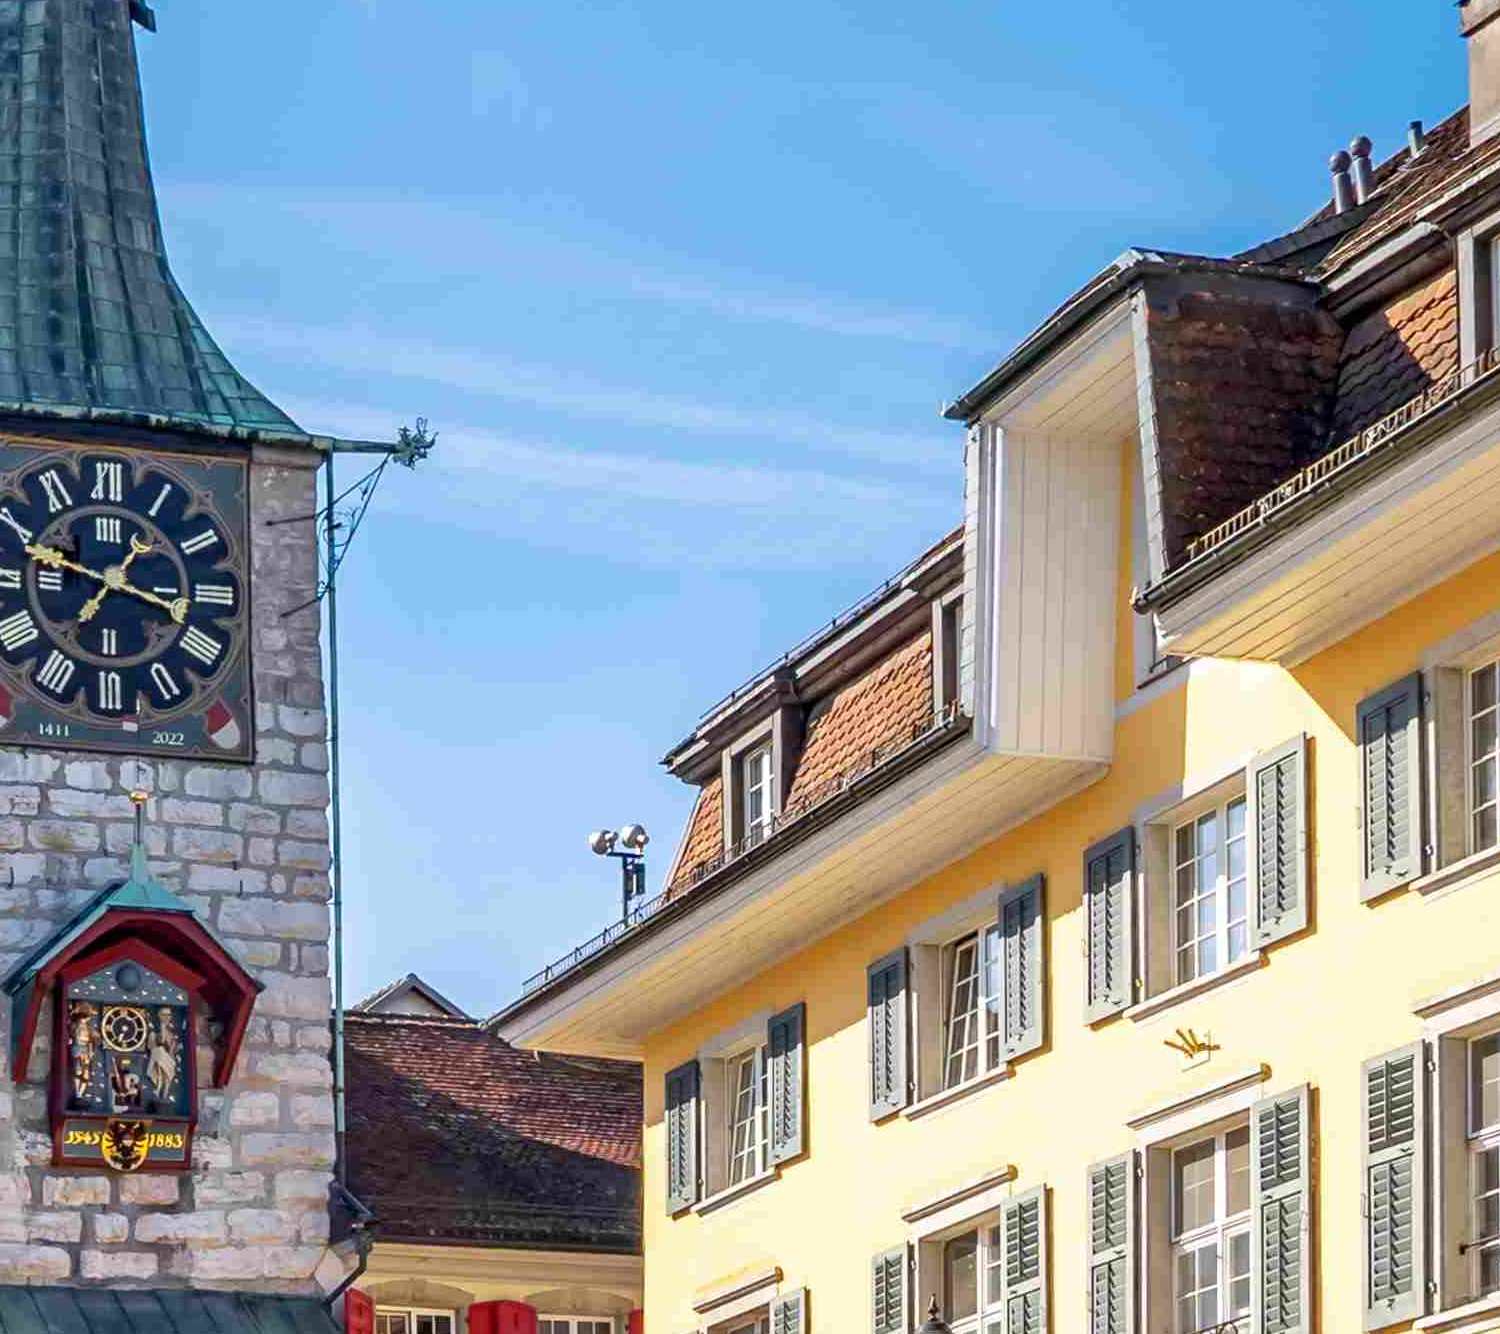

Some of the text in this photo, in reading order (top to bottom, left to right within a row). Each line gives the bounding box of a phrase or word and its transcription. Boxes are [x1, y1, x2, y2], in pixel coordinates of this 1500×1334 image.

[39, 722, 69, 737] 1411
[152, 731, 184, 746] 2022
[149, 1133, 183, 1148] 1883
